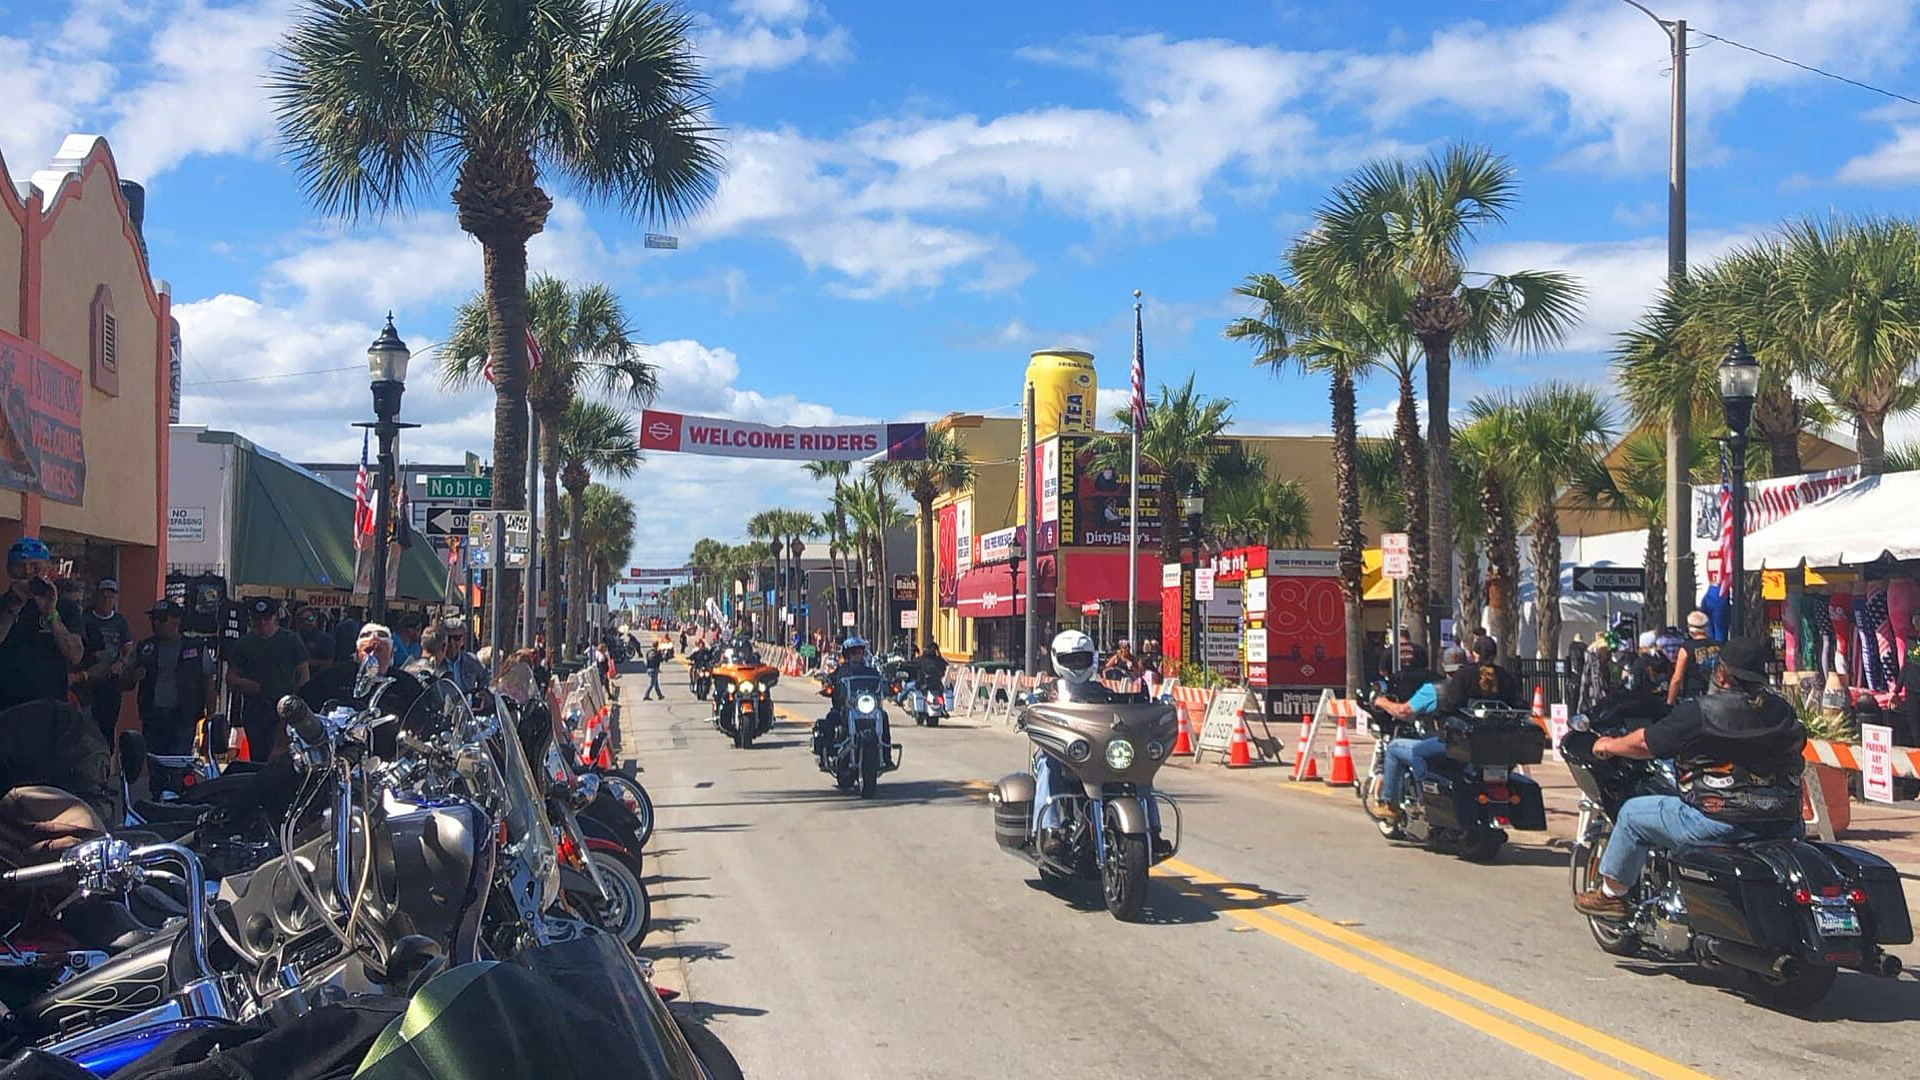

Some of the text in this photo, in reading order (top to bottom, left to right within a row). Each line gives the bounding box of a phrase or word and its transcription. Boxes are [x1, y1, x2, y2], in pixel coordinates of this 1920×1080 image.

[1064, 394, 1083, 425] TEA
[689, 426, 878, 451] WELCOME RIDERS
[1061, 440, 1074, 494] WEEK
[431, 479, 483, 497] Noble
[1061, 500, 1074, 543] BIKE
[896, 580, 917, 590] Bank
[1595, 574, 1637, 584] ONE WAY
[308, 594, 340, 606] OPEN
[1265, 579, 1346, 636] 80
[1866, 742, 1887, 754] PARKING
[1872, 754, 1882, 764] ANY
[1871, 765, 1884, 776] TIME
